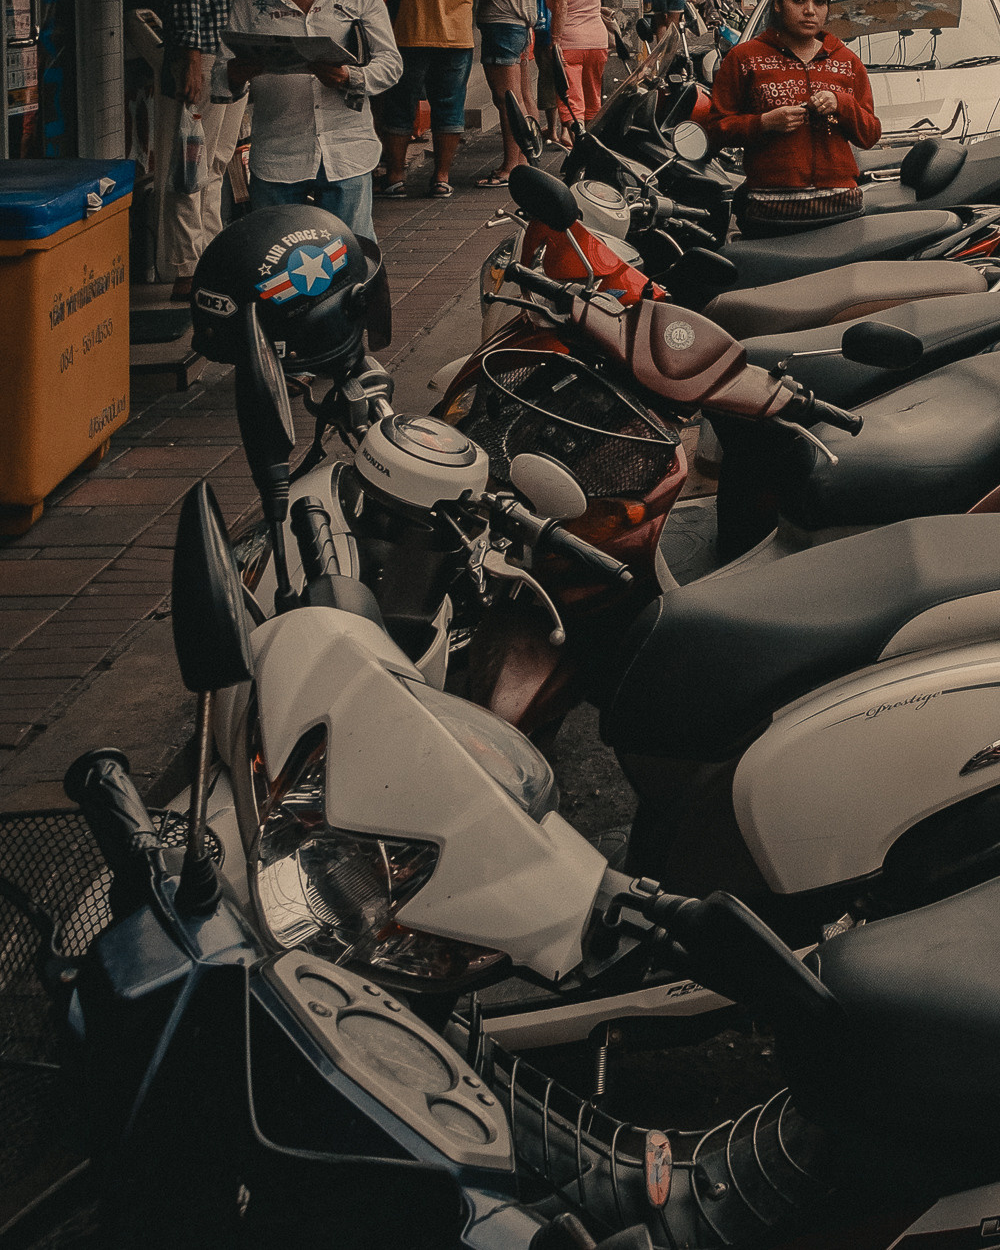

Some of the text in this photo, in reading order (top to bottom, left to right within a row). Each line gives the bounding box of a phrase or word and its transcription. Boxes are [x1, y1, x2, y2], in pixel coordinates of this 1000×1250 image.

[265, 228, 319, 265] AIR FORCE
[361, 447, 392, 479] HONDA
[864, 689, 942, 720] Prestige
